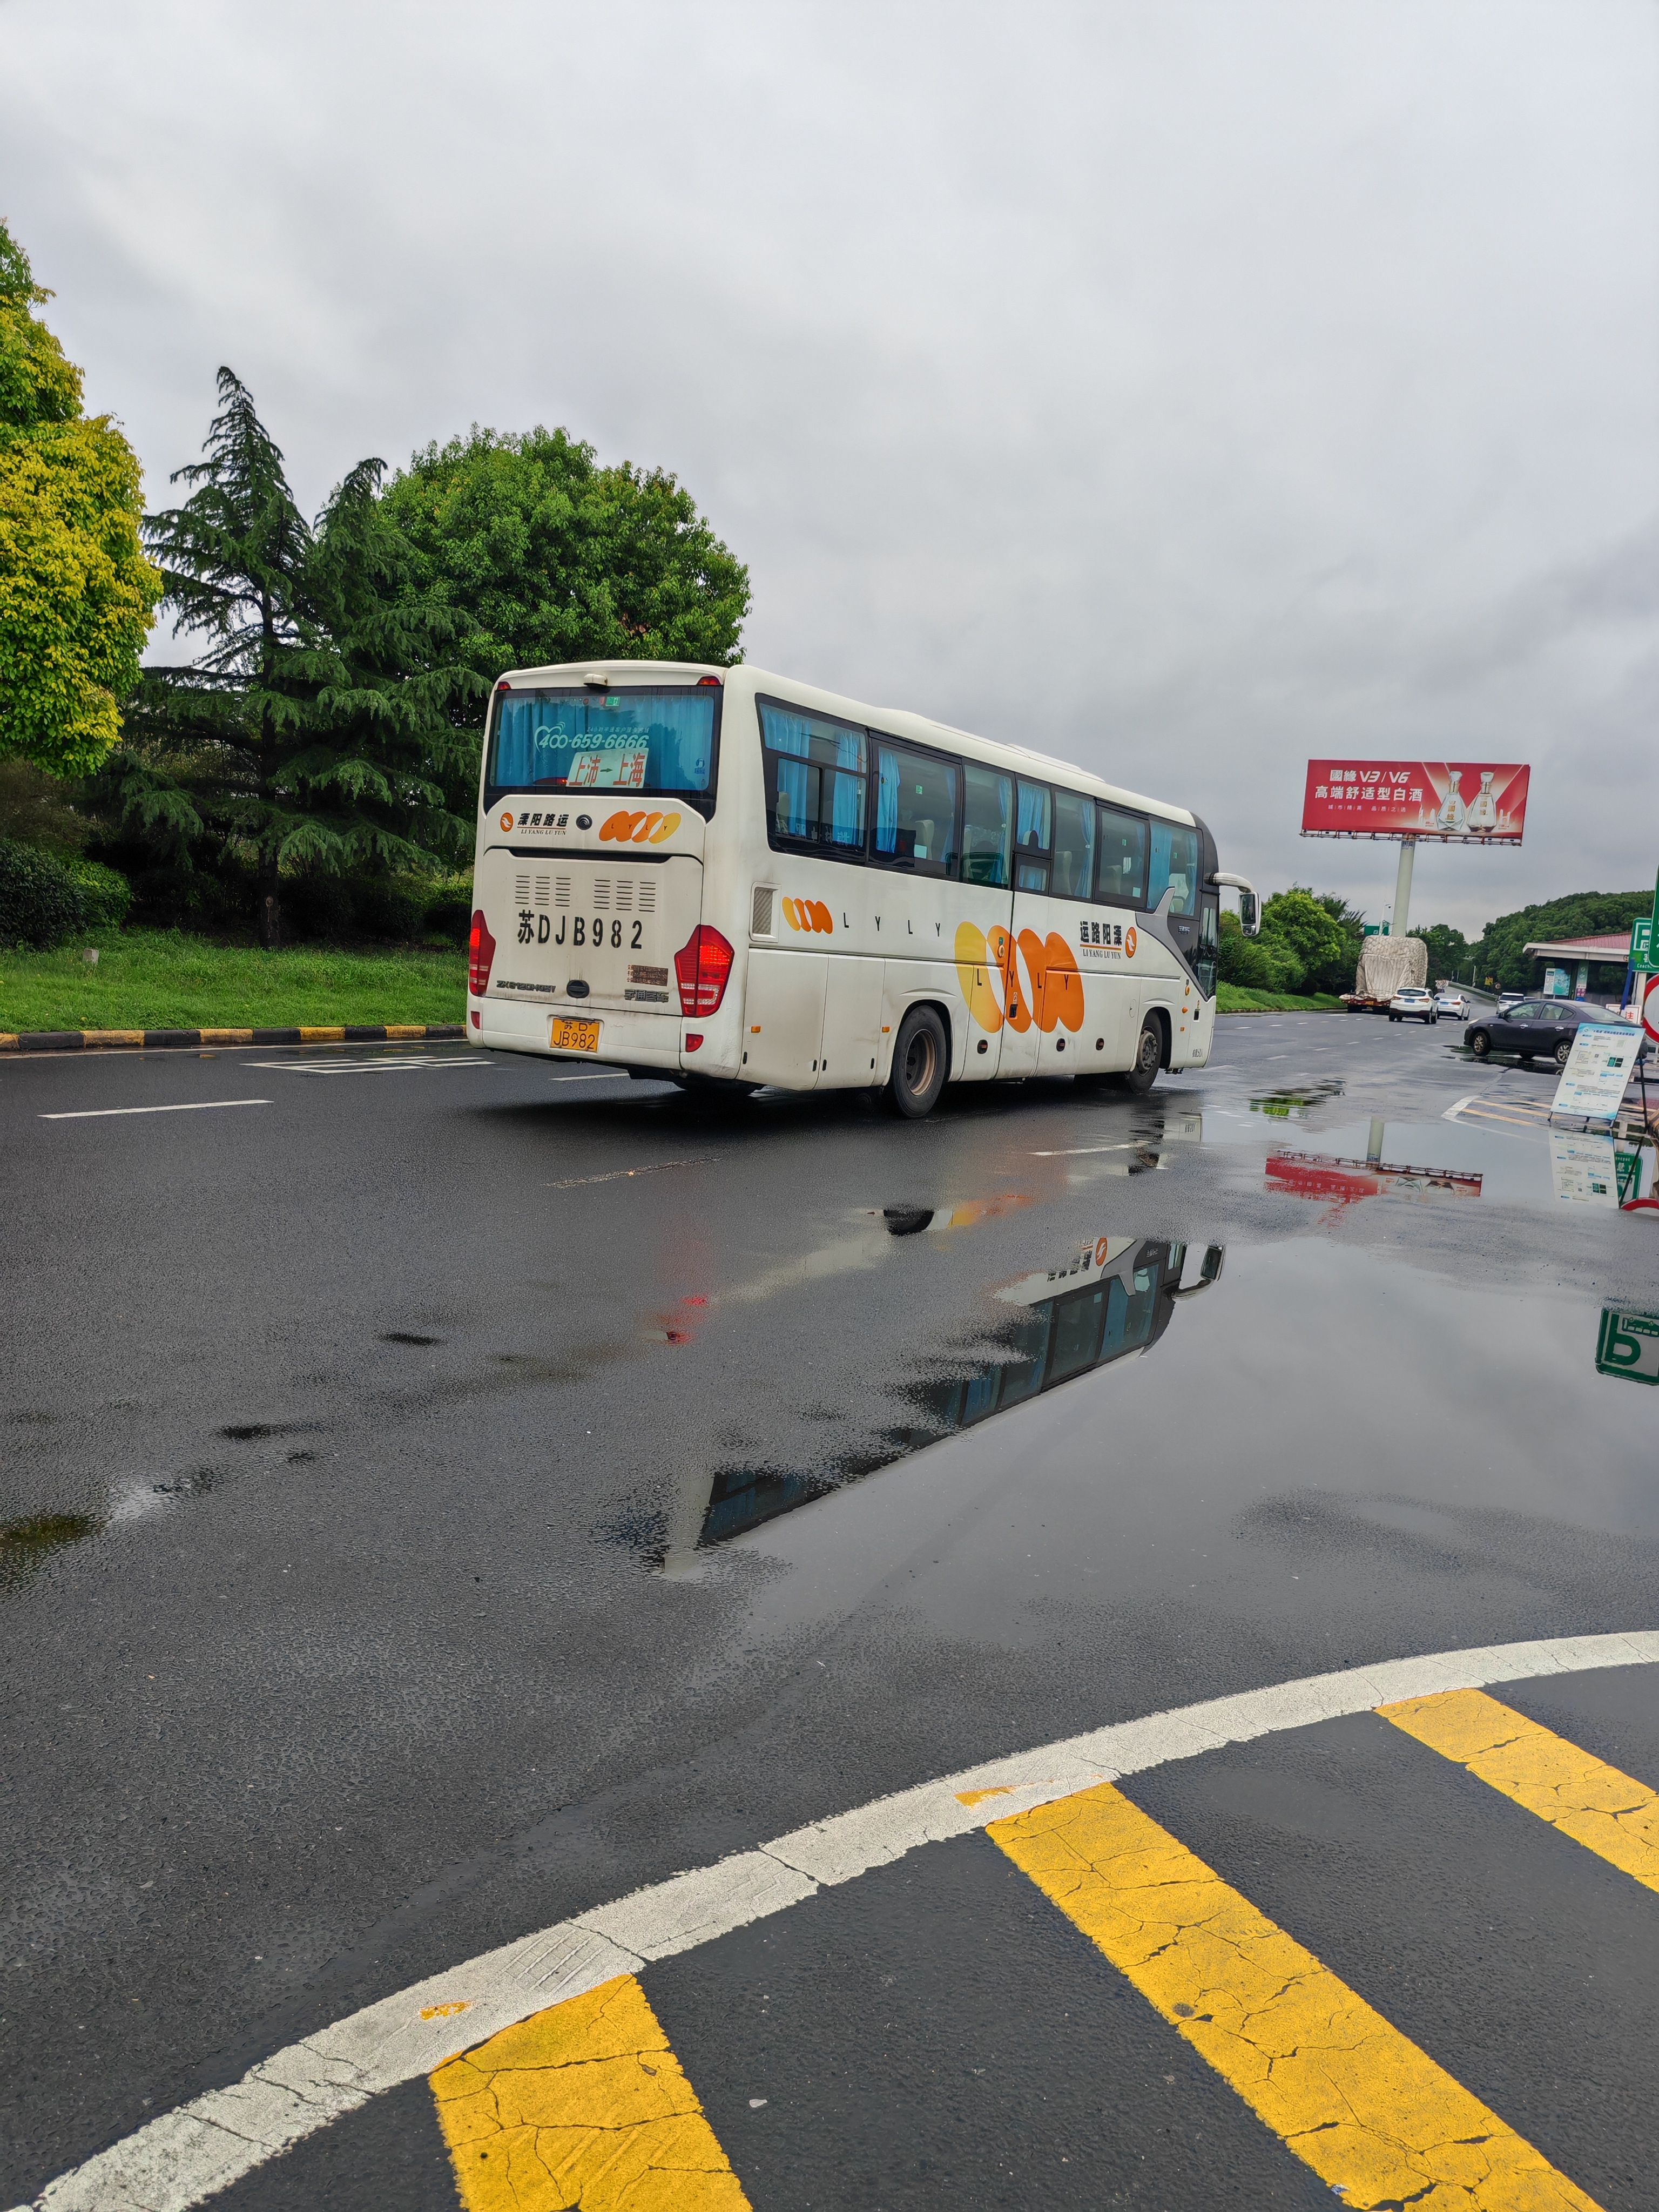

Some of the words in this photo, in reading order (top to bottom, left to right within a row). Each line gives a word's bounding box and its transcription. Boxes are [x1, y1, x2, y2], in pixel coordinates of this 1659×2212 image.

[538, 733, 649, 749] 400-659-6666
[613, 752, 645, 787] 上海
[1315, 785, 1423, 802] 高端舒适型白酒
[518, 813, 569, 827] 溧阳路运
[517, 909, 643, 949] 苏DJB982
[553, 1030, 595, 1050] JB982
